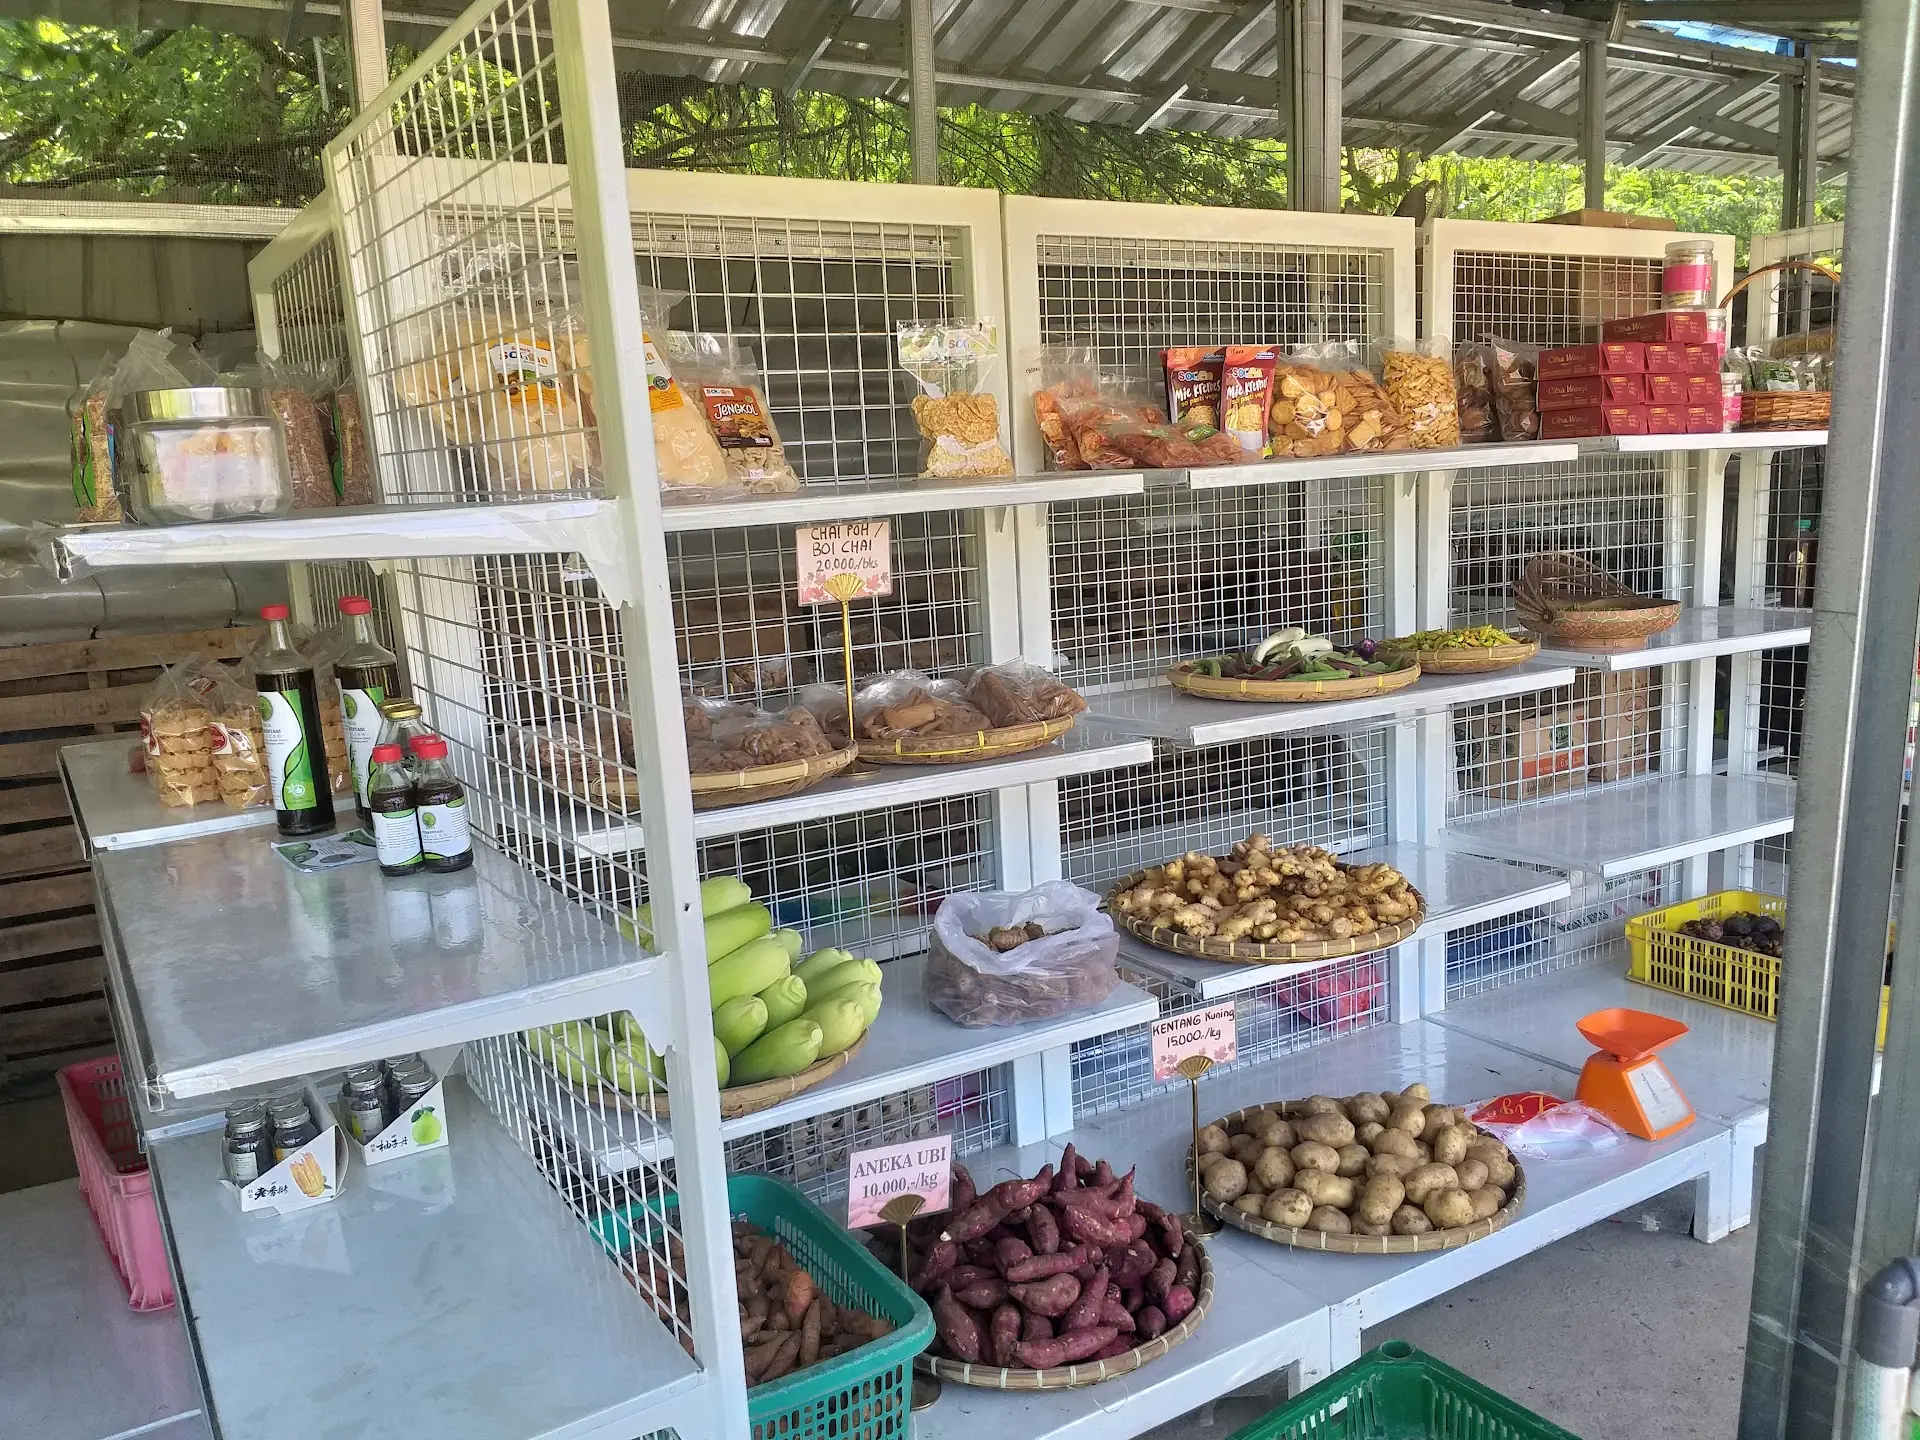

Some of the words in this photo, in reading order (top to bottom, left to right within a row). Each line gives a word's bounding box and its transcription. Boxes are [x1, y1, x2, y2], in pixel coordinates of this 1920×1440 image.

[1175, 387, 1192, 402] Mie
[1226, 384, 1245, 400] Mie
[810, 525, 841, 541] CHAI
[846, 522, 869, 538] POH
[812, 541, 835, 557] BOI
[841, 539, 872, 554] CHAI
[1152, 1014, 1201, 1037] KENTANG
[1204, 1008, 1235, 1022] Kuning
[853, 1153, 913, 1179] ANEKA
[917, 1146, 947, 1166] UBI
[862, 1172, 939, 1199] 10.000,-/kg
